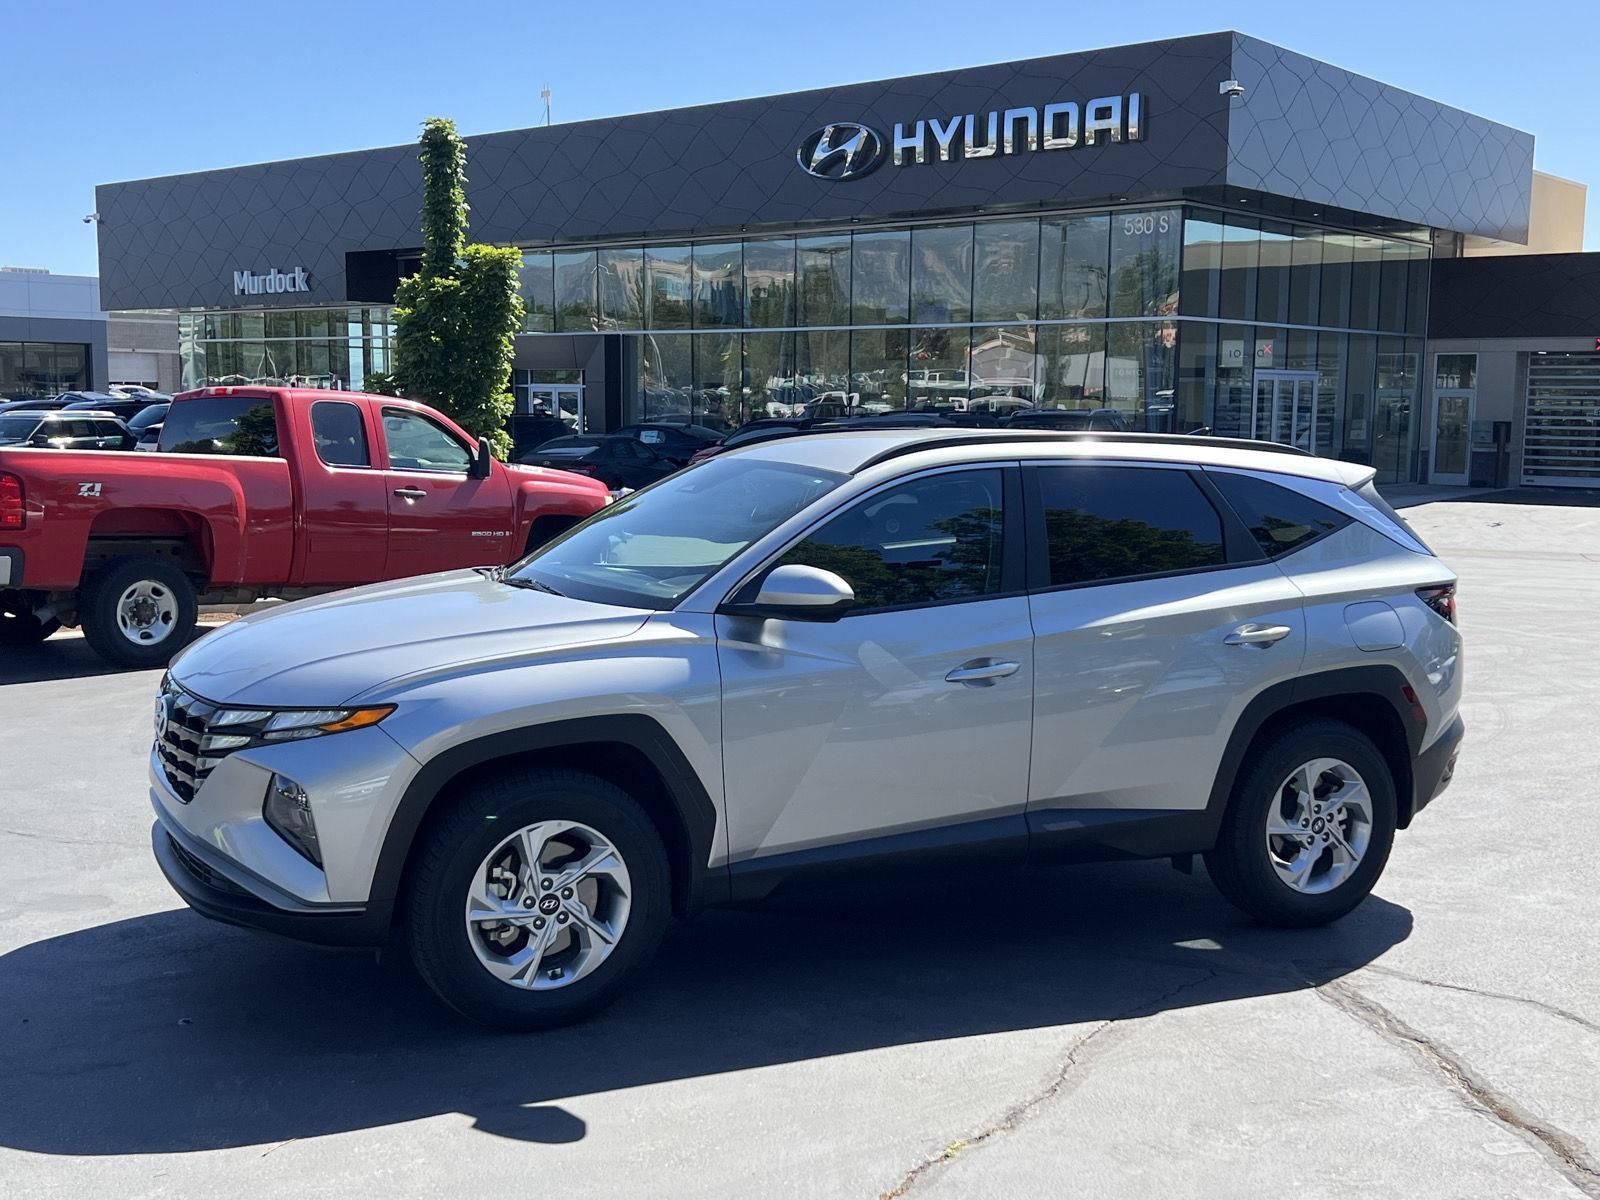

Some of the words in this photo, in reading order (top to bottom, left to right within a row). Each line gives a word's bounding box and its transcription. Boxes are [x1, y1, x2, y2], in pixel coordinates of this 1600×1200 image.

[893, 92, 1140, 166] HYUNDAI
[1123, 216, 1154, 236] 530
[1159, 215, 1169, 233] S
[233, 266, 310, 296] Murdock
